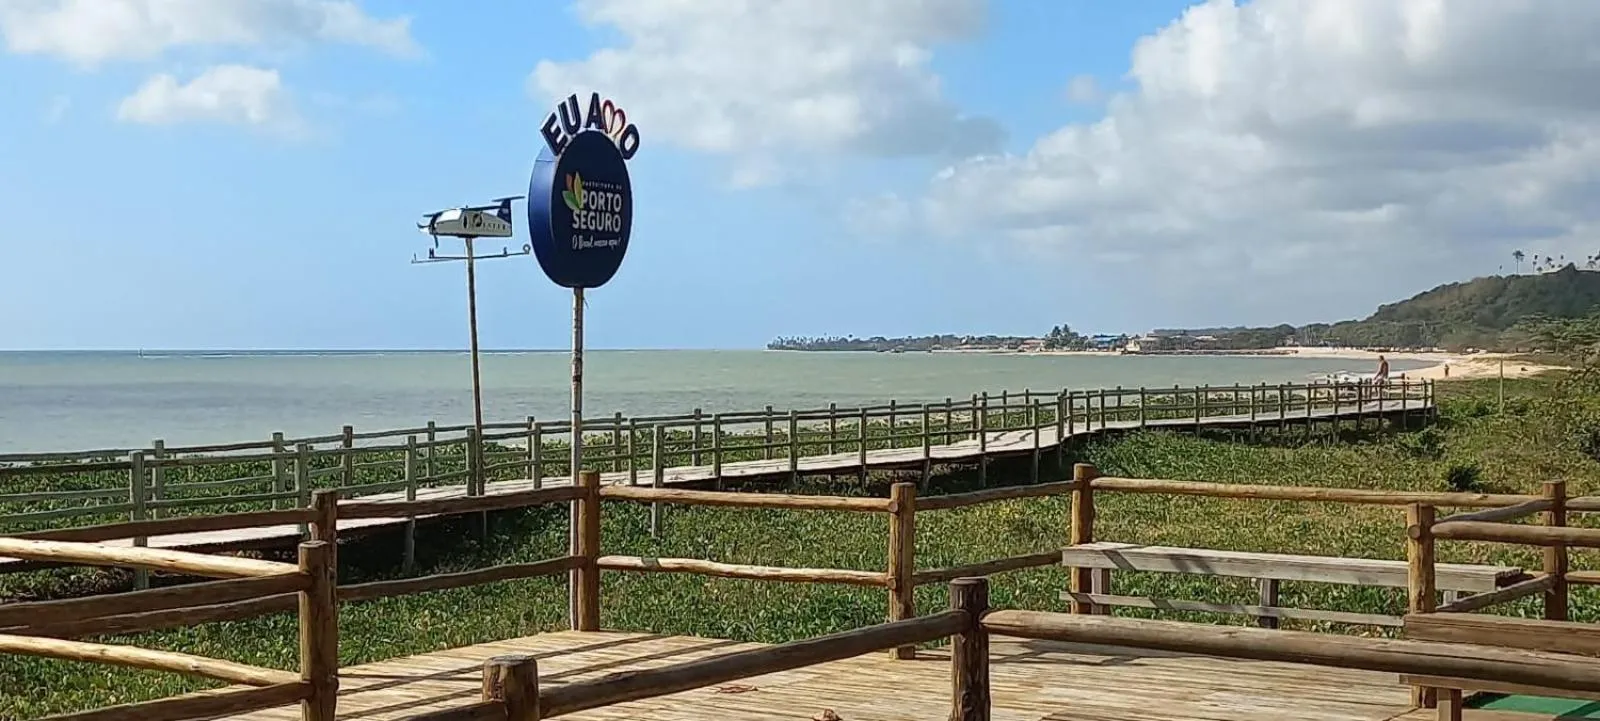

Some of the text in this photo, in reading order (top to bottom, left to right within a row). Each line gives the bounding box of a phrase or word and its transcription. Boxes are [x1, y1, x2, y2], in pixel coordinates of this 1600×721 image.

[540, 93, 581, 157] EU
[581, 189, 622, 213] PORTO
[572, 209, 621, 233] SEGURO
